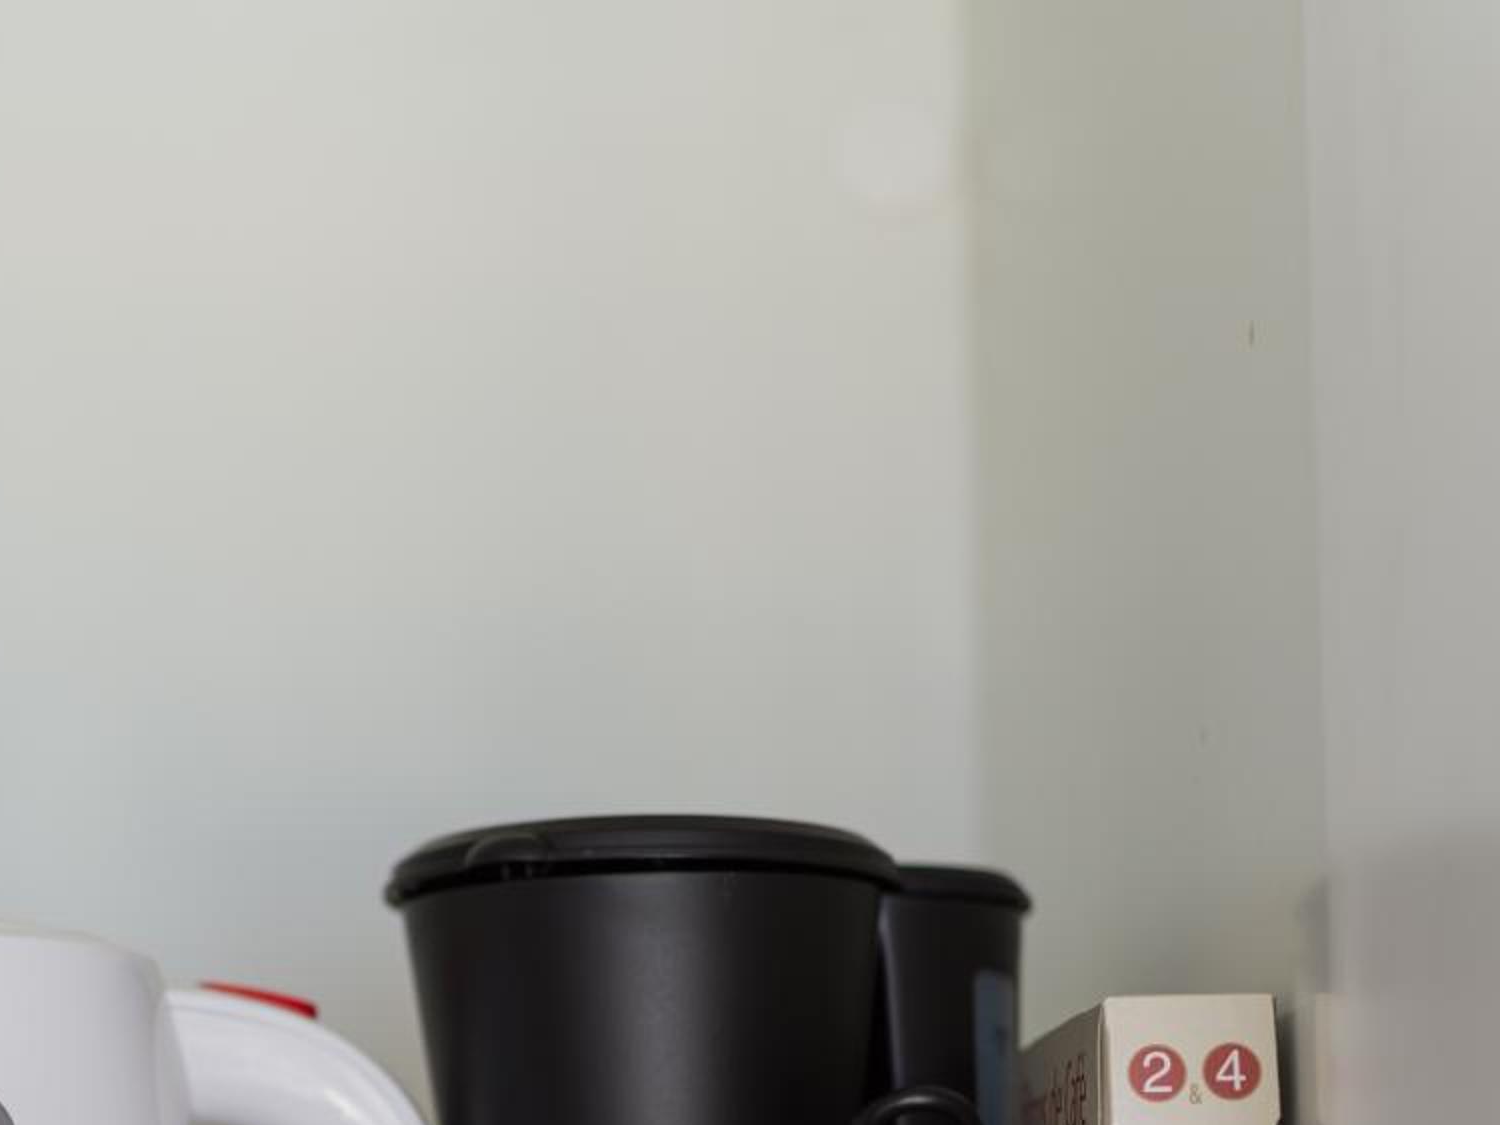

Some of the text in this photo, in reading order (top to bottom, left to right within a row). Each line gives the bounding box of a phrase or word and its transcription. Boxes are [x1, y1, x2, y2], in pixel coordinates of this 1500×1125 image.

[1142, 1049, 1247, 1105] 2 & 4
